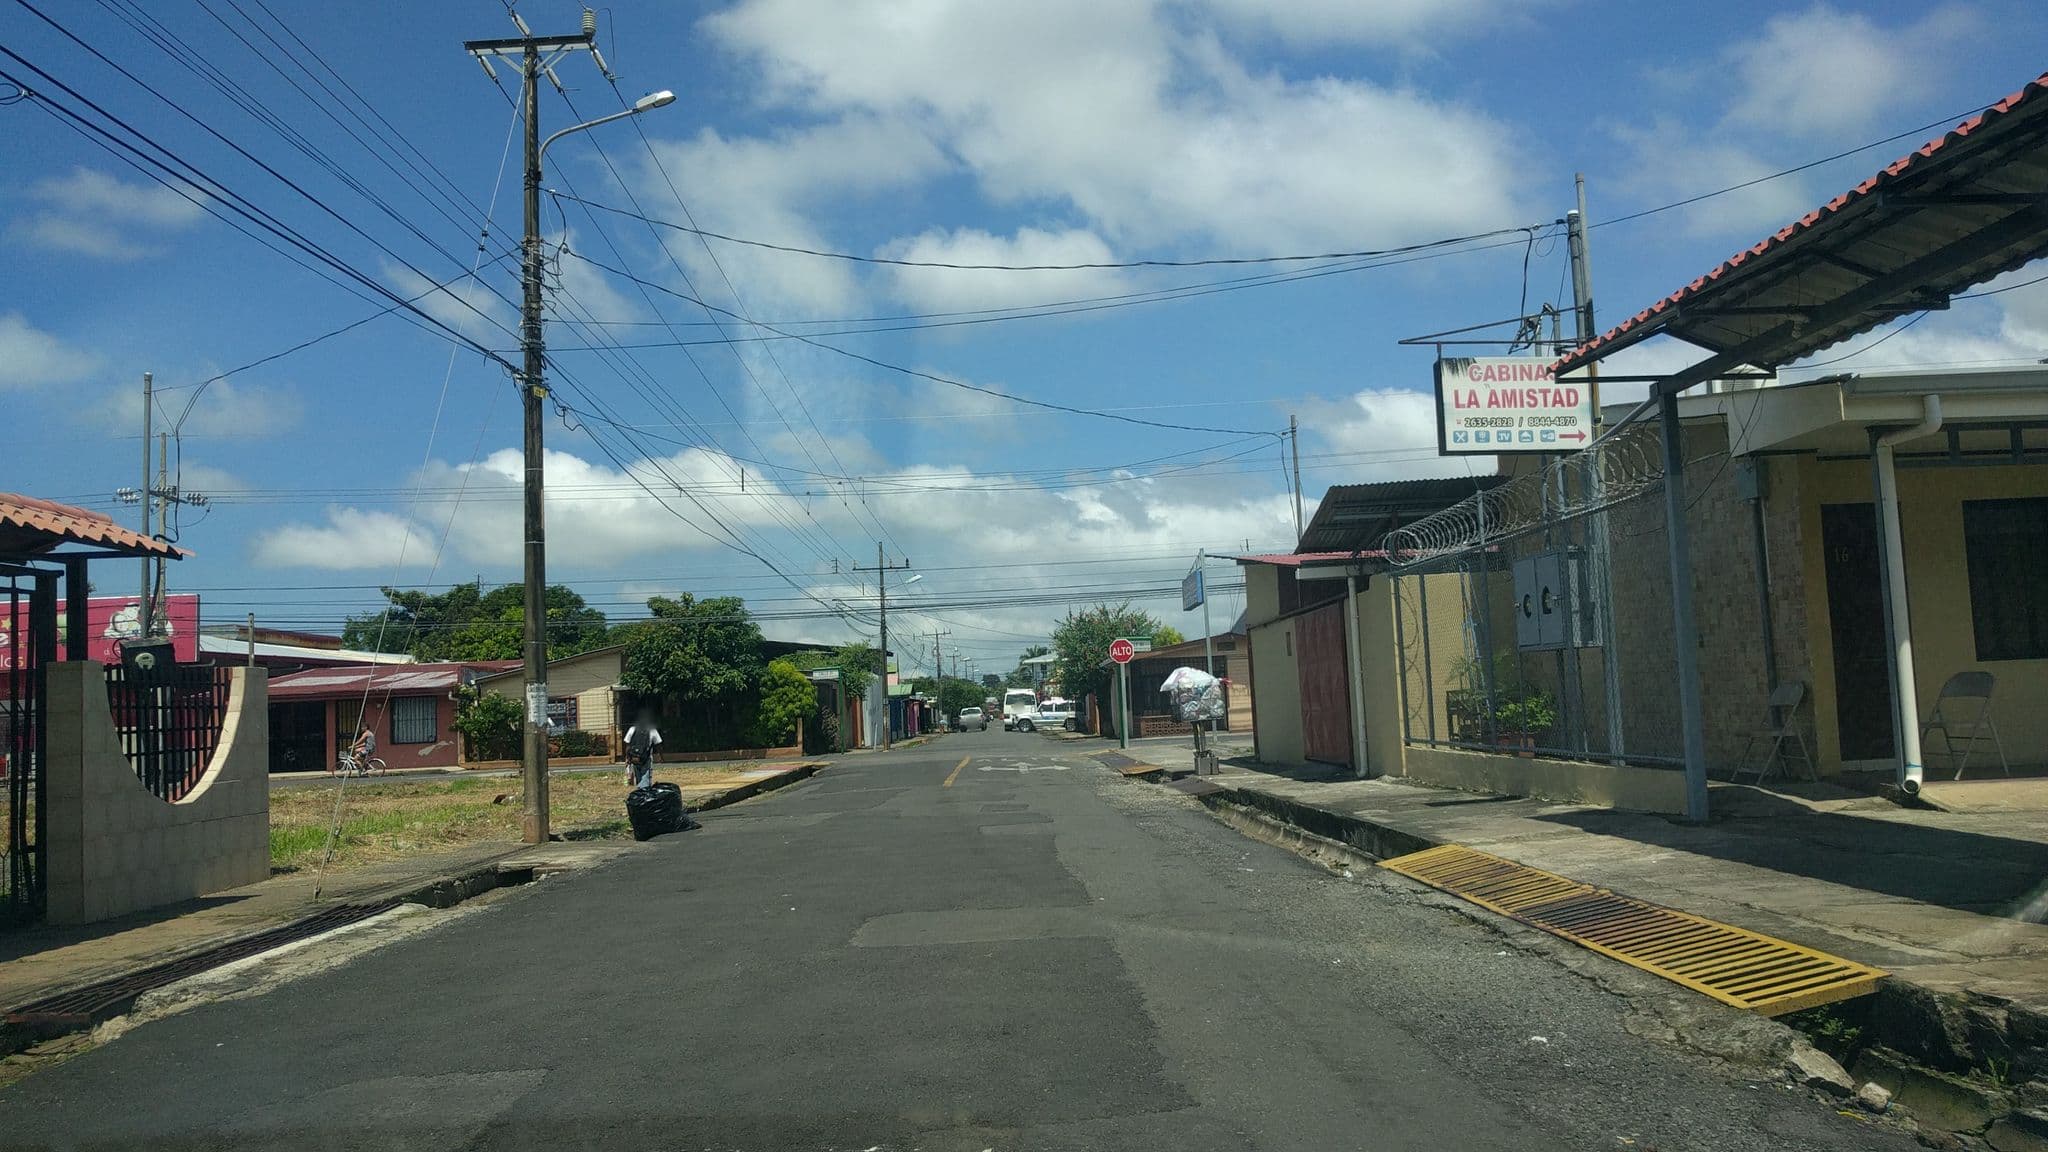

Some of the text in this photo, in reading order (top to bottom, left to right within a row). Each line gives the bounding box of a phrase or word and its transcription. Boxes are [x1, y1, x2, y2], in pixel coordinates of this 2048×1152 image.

[1468, 364, 1556, 382] CABINA
[1454, 388, 1579, 409] LA AMISTAD
[1464, 417, 1514, 428] 2635-2828
[1527, 416, 1577, 427] 8844-4870
[1112, 646, 1132, 656] ALTO
